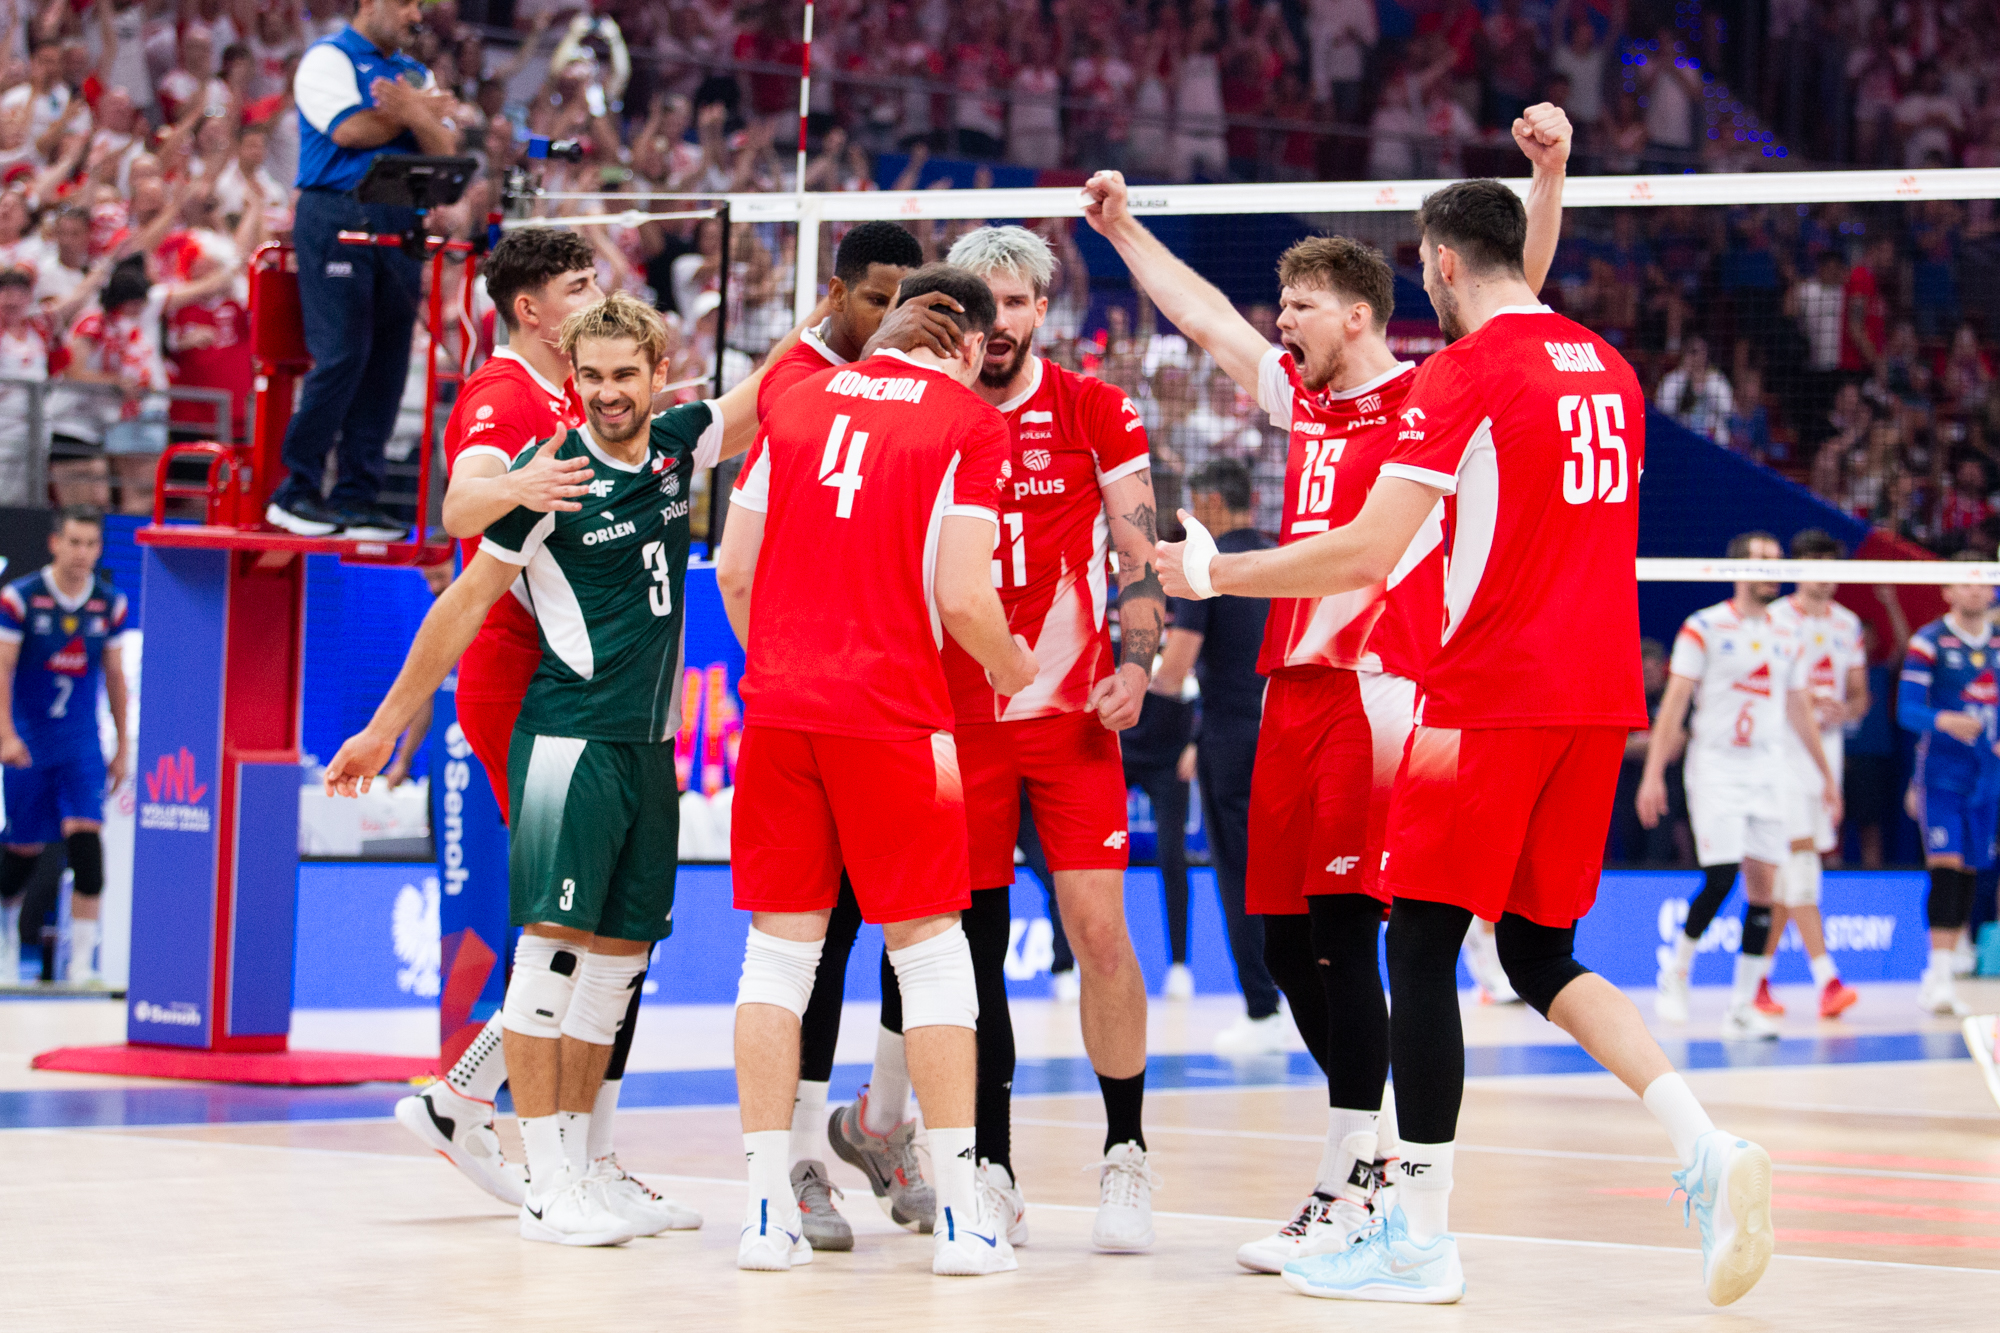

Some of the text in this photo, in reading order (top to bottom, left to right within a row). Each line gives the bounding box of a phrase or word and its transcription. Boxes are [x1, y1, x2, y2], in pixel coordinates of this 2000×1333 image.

[1544, 341, 1606, 372] SASAK
[825, 370, 928, 404] KOMENDA
[1020, 432, 1053, 441] POLSKA
[1557, 394, 1628, 505] 35
[818, 414, 870, 519] 4
[1297, 438, 1348, 515] 15
[1014, 477, 1066, 500] plus
[660, 500, 688, 526] plus
[582, 520, 637, 546] ORLEN
[642, 540, 672, 617] 3
[145, 746, 208, 806] VNL
[445, 758, 471, 896] Senoh
[1103, 830, 1127, 849] 4F
[1325, 856, 1360, 875] 4F
[559, 878, 576, 911] 3
